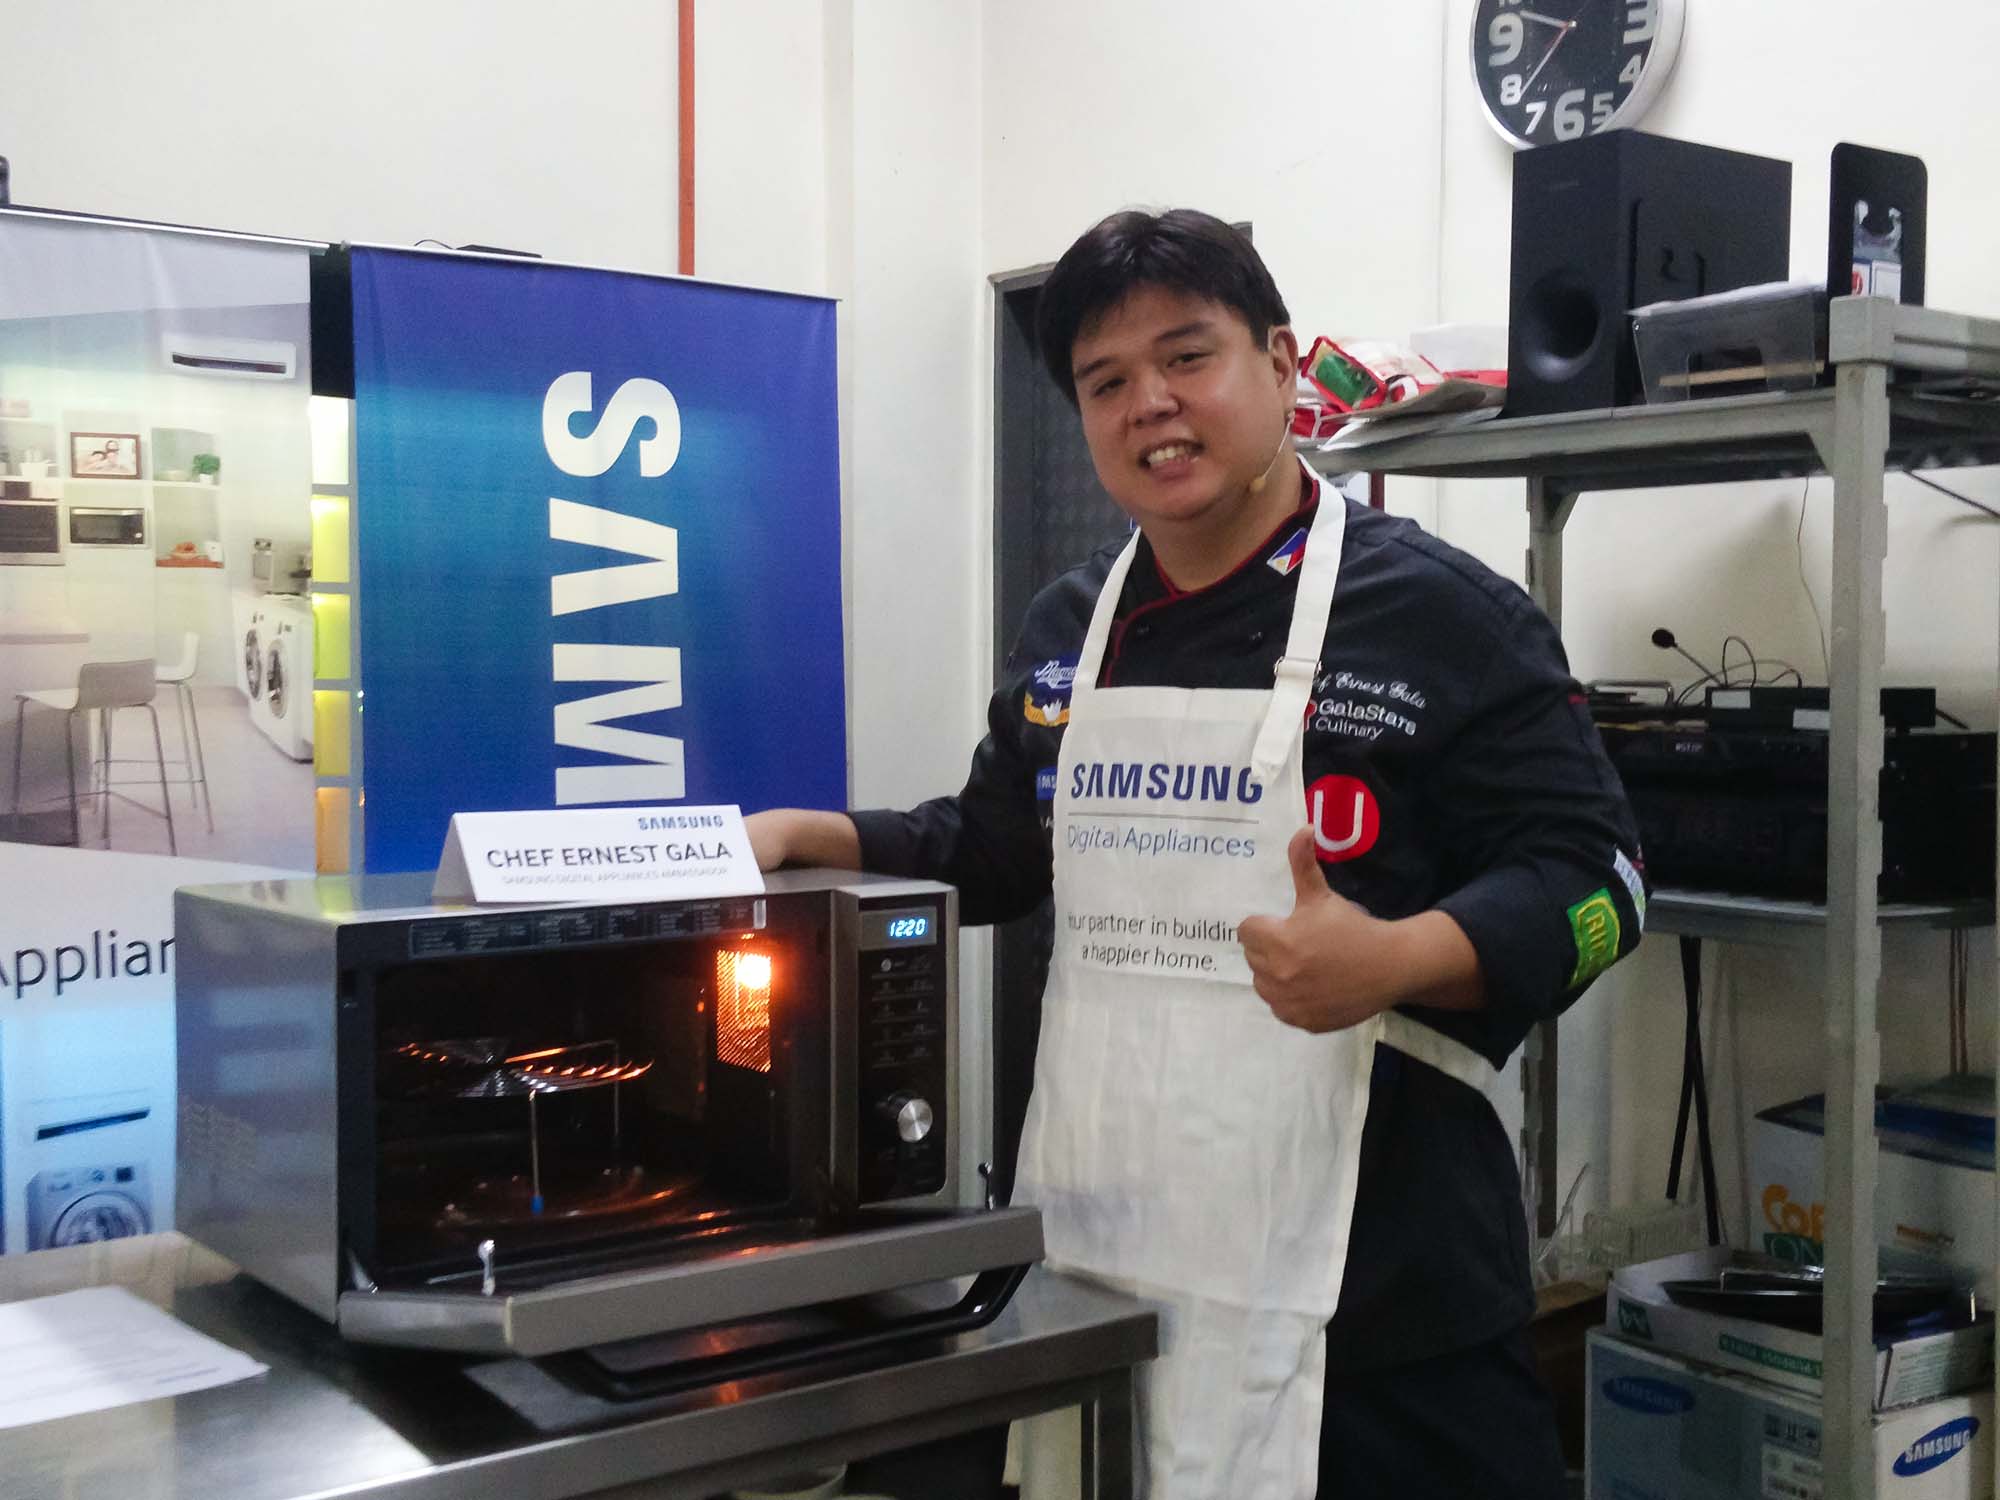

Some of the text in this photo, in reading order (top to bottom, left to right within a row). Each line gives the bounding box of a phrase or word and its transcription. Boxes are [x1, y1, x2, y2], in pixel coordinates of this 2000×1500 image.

[1488, 12, 1524, 67] 9
[1623, 0, 1657, 45] 3
[1619, 53, 1643, 87] 4
[1500, 74, 1523, 106] 8
[1525, 101, 1548, 135] 7
[1554, 88, 1586, 142] 6
[1591, 92, 1615, 127] 5
[542, 371, 686, 806] SAM
[1315, 716, 1384, 741] Culinary
[1318, 698, 1417, 736] GalaStars
[1071, 763, 1263, 804] SAMSUNG
[638, 815, 724, 831] SAMSUNG
[1314, 790, 1364, 852] U
[487, 842, 732, 868] CHEF ERNEST GALA
[1067, 825, 1256, 858] Digital Appliances
[1088, 914, 1146, 935] partner
[1151, 915, 1167, 936] in
[1082, 943, 1217, 972] a happier home.
[1904, 1429, 1971, 1464] SAMSUNG
